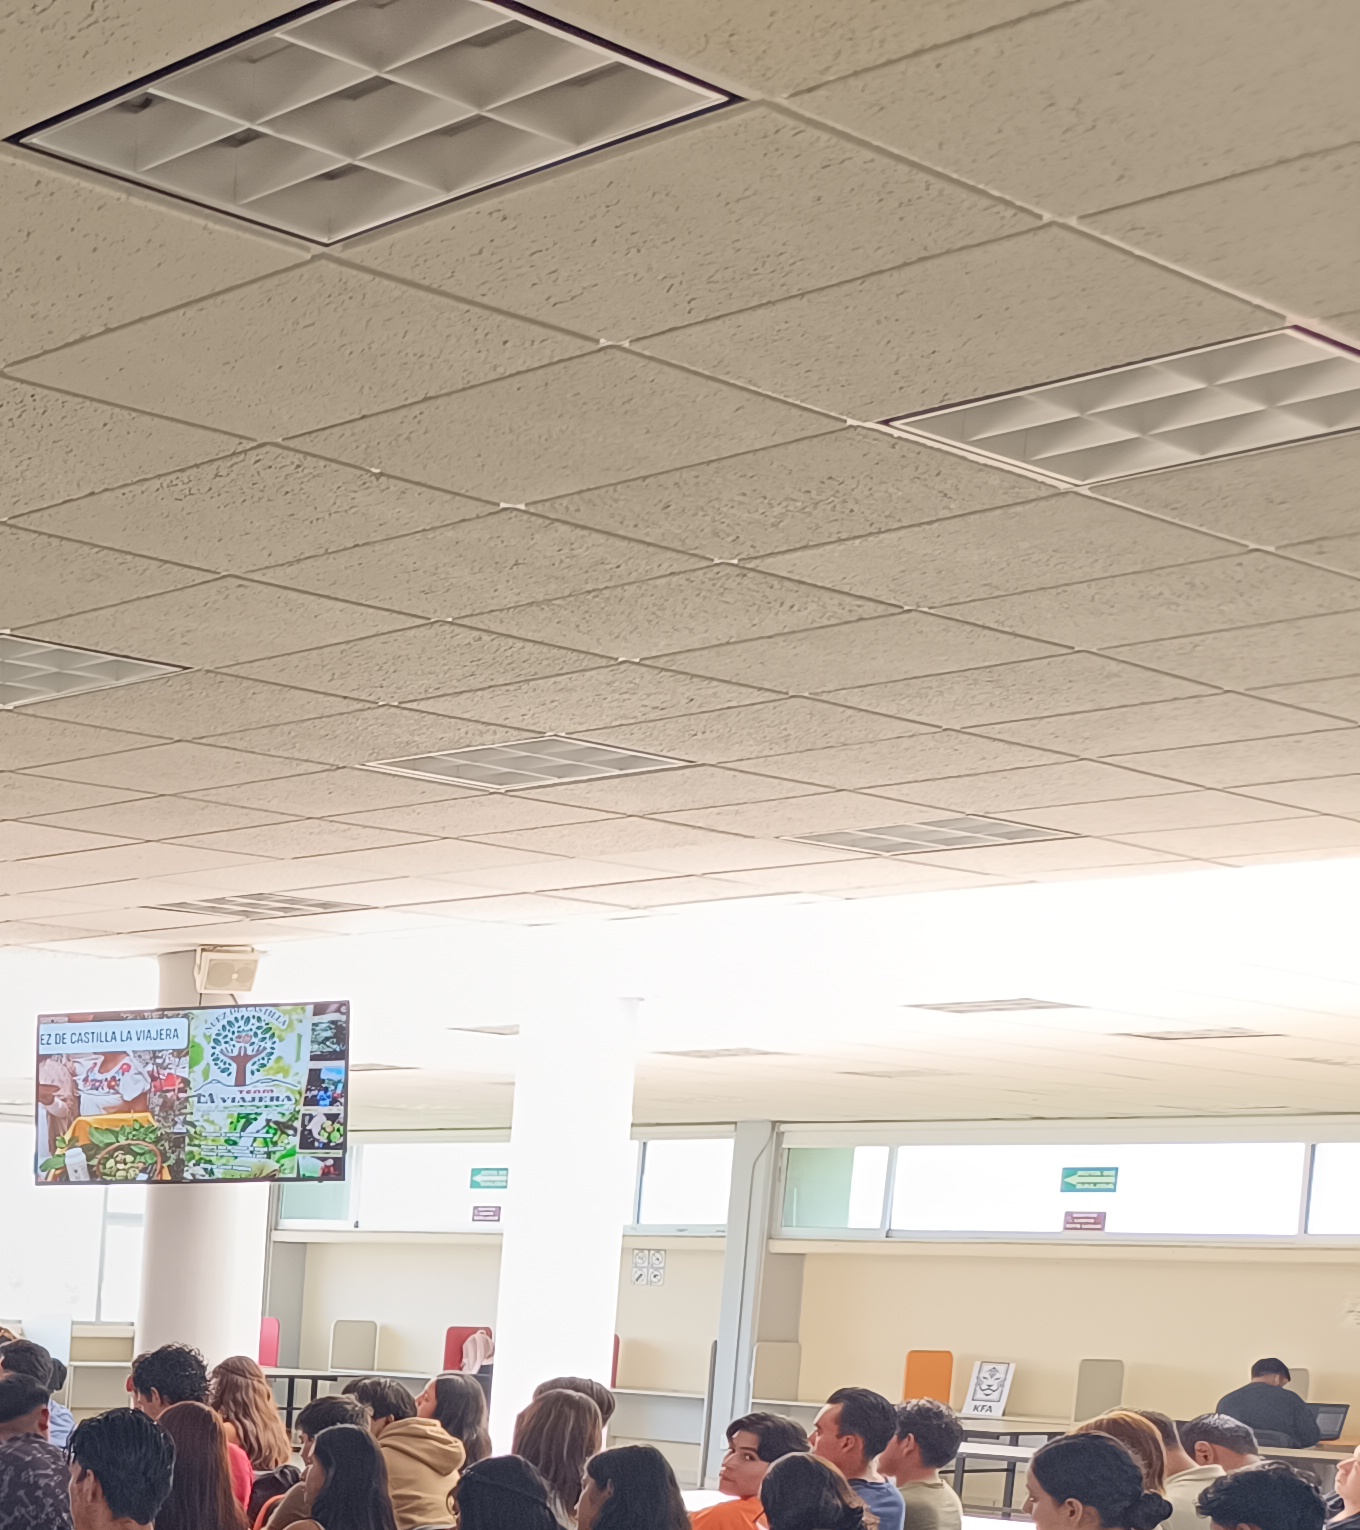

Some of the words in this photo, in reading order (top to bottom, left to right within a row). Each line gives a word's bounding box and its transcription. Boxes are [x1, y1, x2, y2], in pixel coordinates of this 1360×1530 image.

[55, 1032, 67, 1045] DE
[70, 1031, 117, 1045] CASTILLA
[120, 1030, 133, 1042] LA
[135, 1028, 180, 1042] VIAJERA
[972, 1404, 992, 1413] KFA
